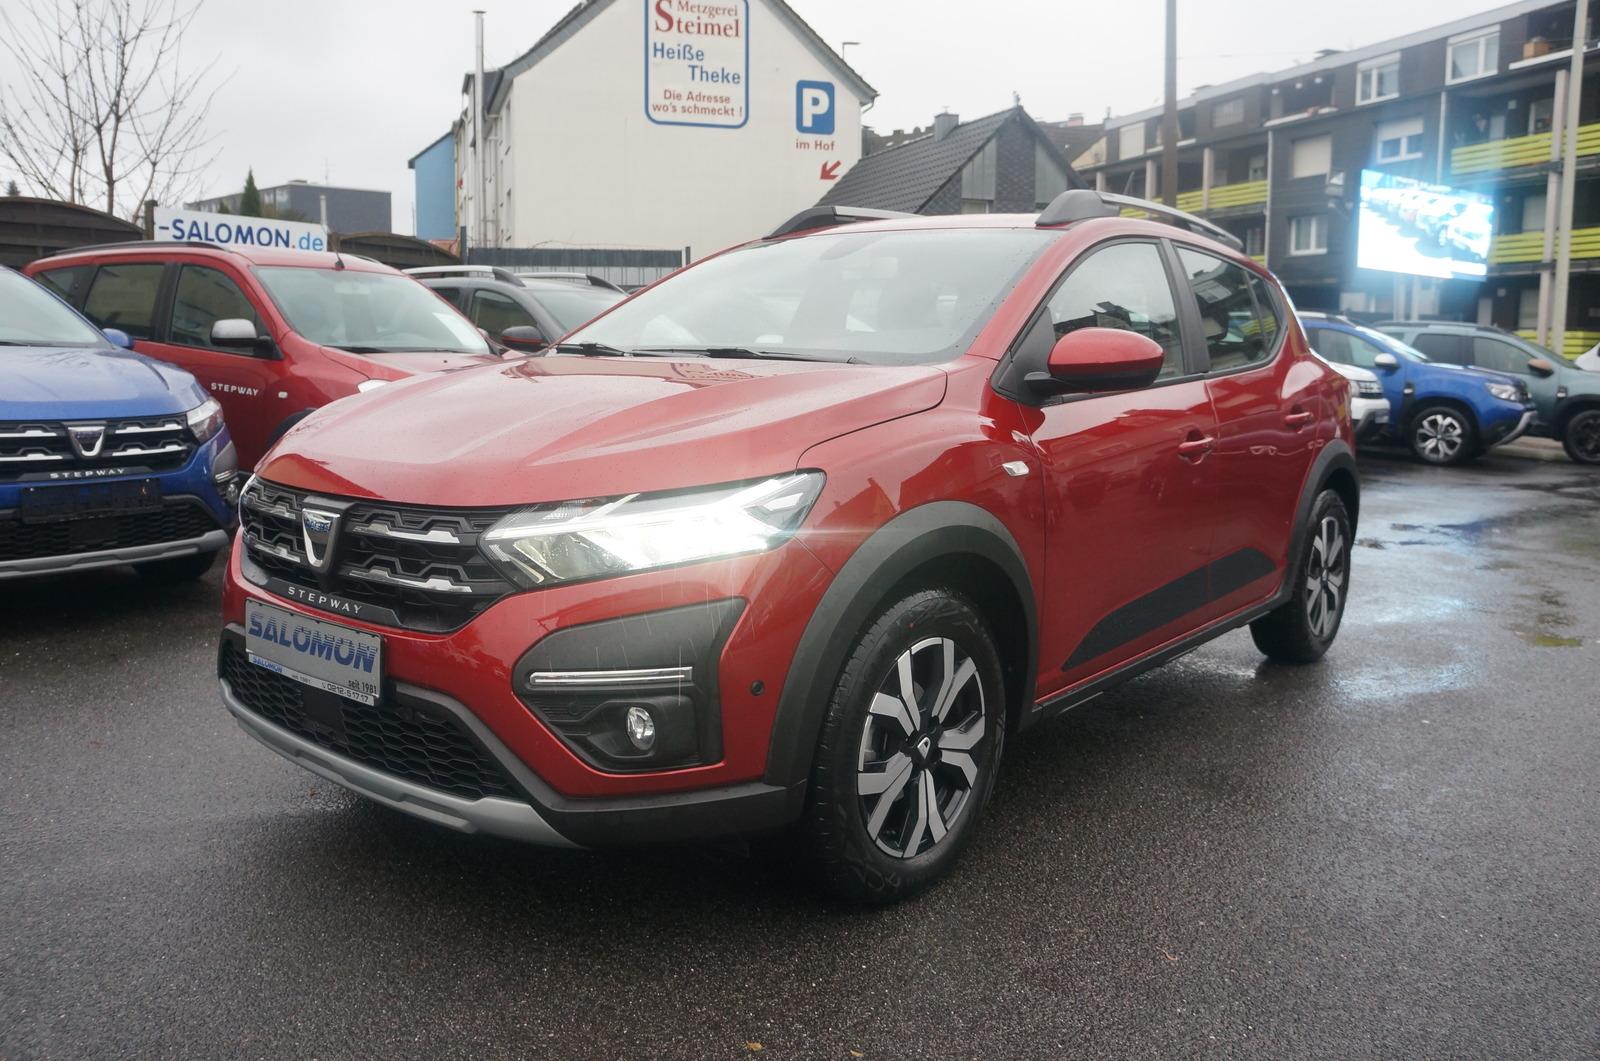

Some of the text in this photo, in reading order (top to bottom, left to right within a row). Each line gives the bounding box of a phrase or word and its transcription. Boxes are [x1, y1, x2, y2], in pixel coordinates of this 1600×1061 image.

[655, 0, 740, 37] Steimel
[677, 1, 738, 18] Metzgerei
[653, 42, 705, 61] Heiße
[688, 65, 741, 84] Theke
[663, 89, 731, 103] Die Adresse
[652, 102, 677, 113] wo's
[681, 104, 735, 116] schmeckt
[802, 87, 830, 128] P
[795, 139, 835, 151] im Hof
[211, 382, 259, 396] STEPWAY
[50, 468, 125, 479] STEPWAY
[288, 586, 362, 614] STEPWAY
[248, 613, 378, 673] SALOMON
